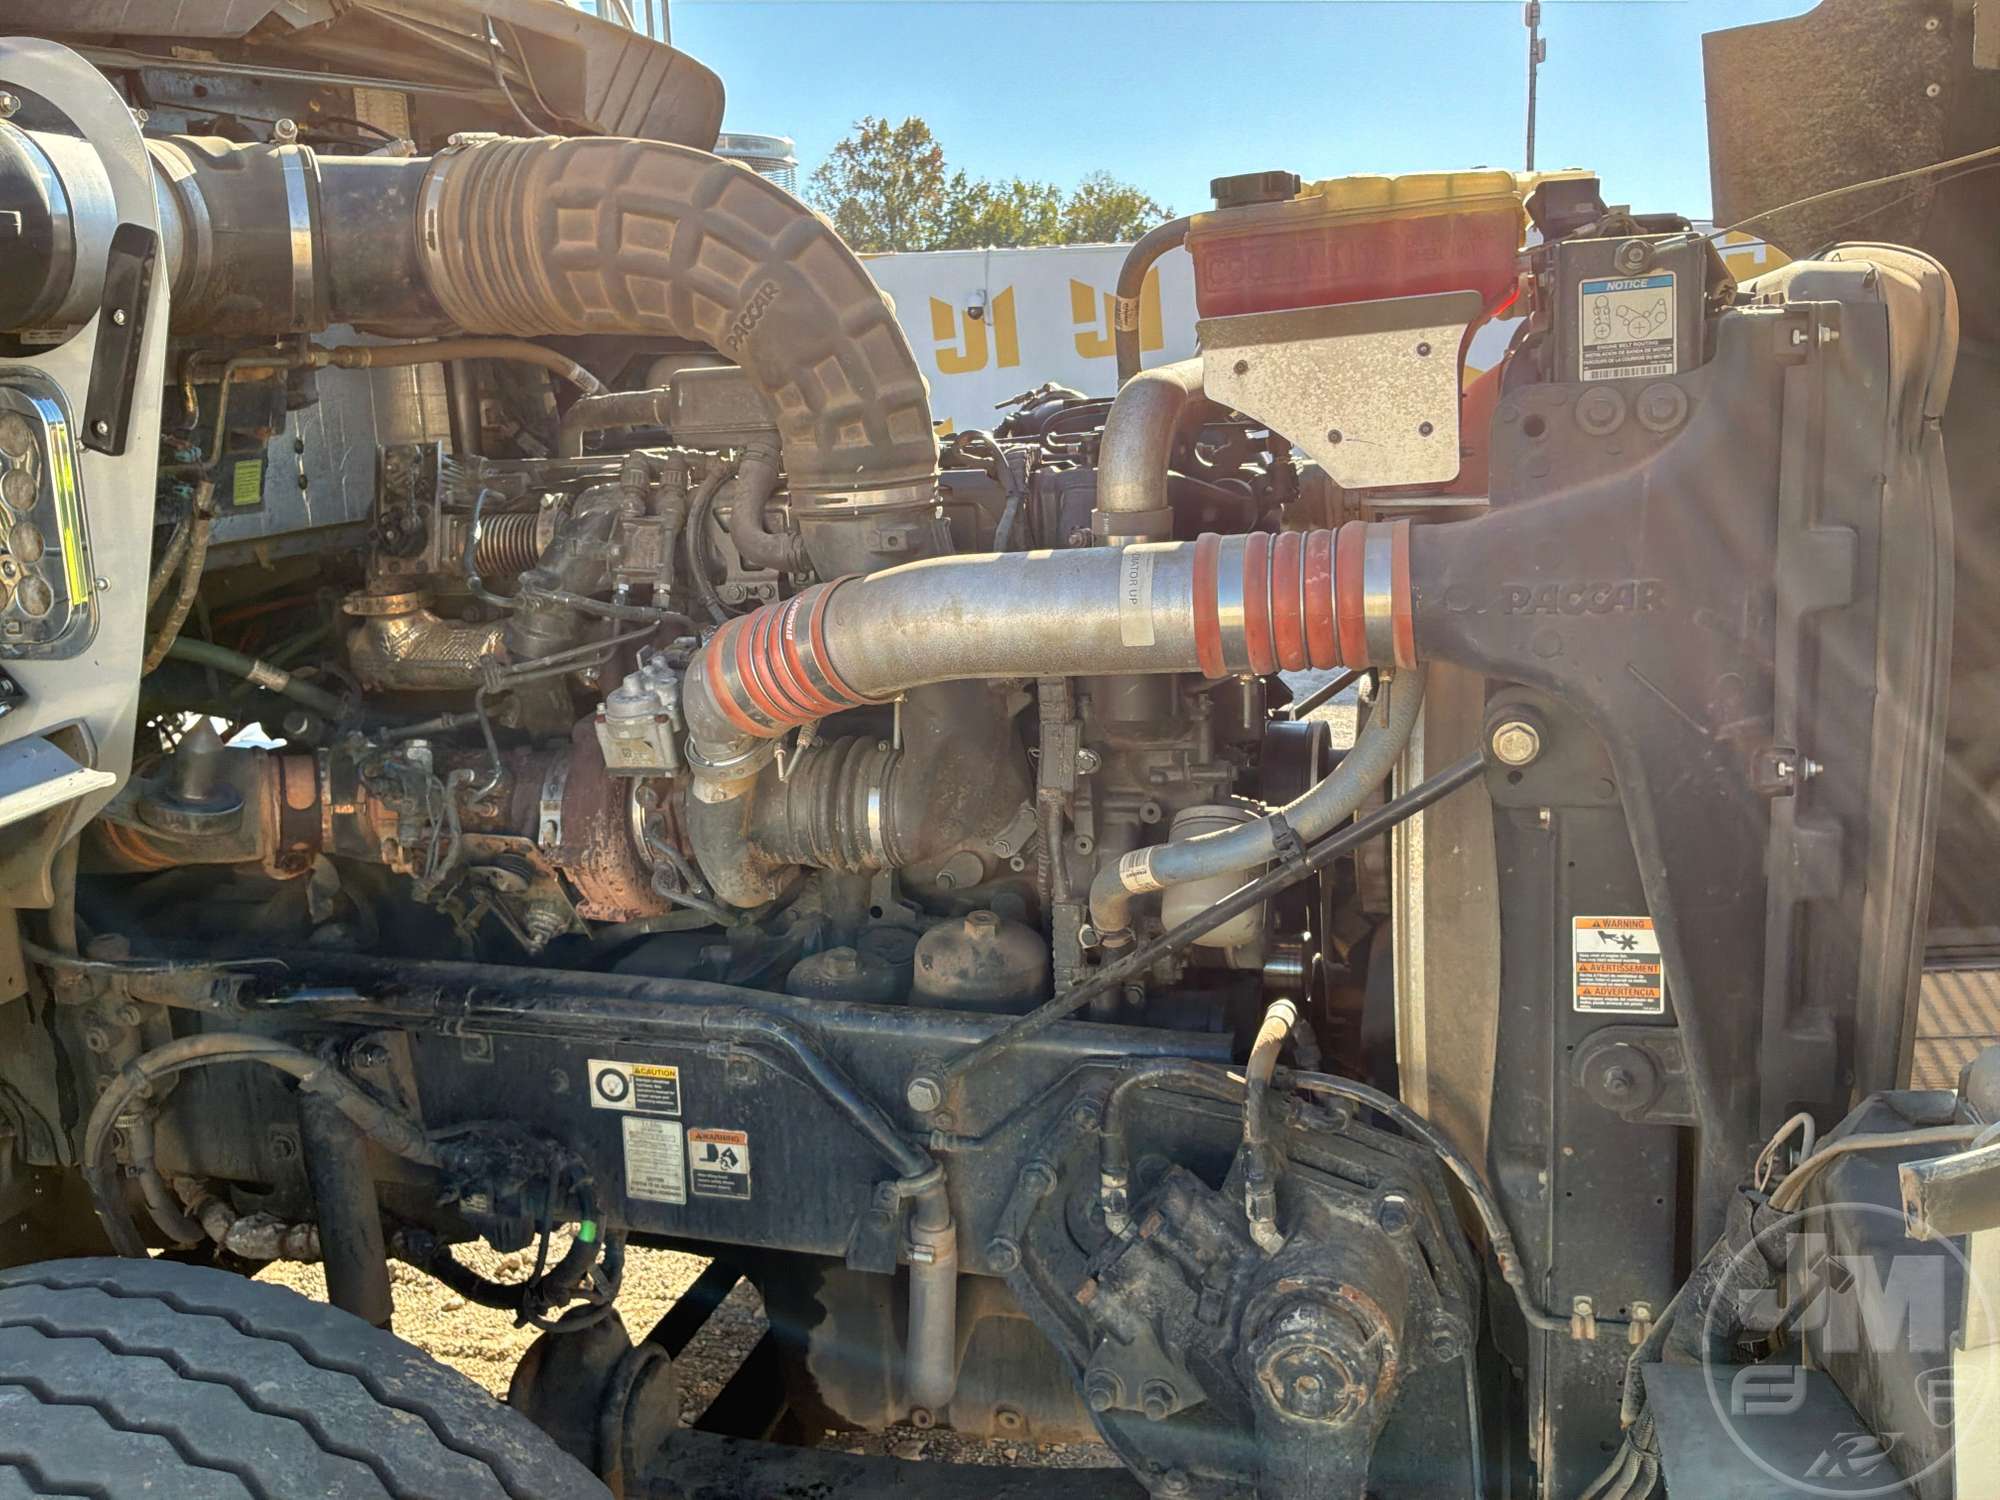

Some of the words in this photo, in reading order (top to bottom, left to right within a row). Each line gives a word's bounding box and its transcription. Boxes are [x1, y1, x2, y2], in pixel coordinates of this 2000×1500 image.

[1606, 280, 1648, 291] NOTICE
[726, 281, 780, 352] PACCAR
[1127, 590, 1138, 605] UP
[1503, 579, 1665, 616] PACCAR
[1603, 920, 1645, 928] WARNING
[1591, 964, 1658, 972] AVERTISSEMENT
[1595, 988, 1655, 996] ADVERTENCIA
[640, 1068, 676, 1077] CAUTION
